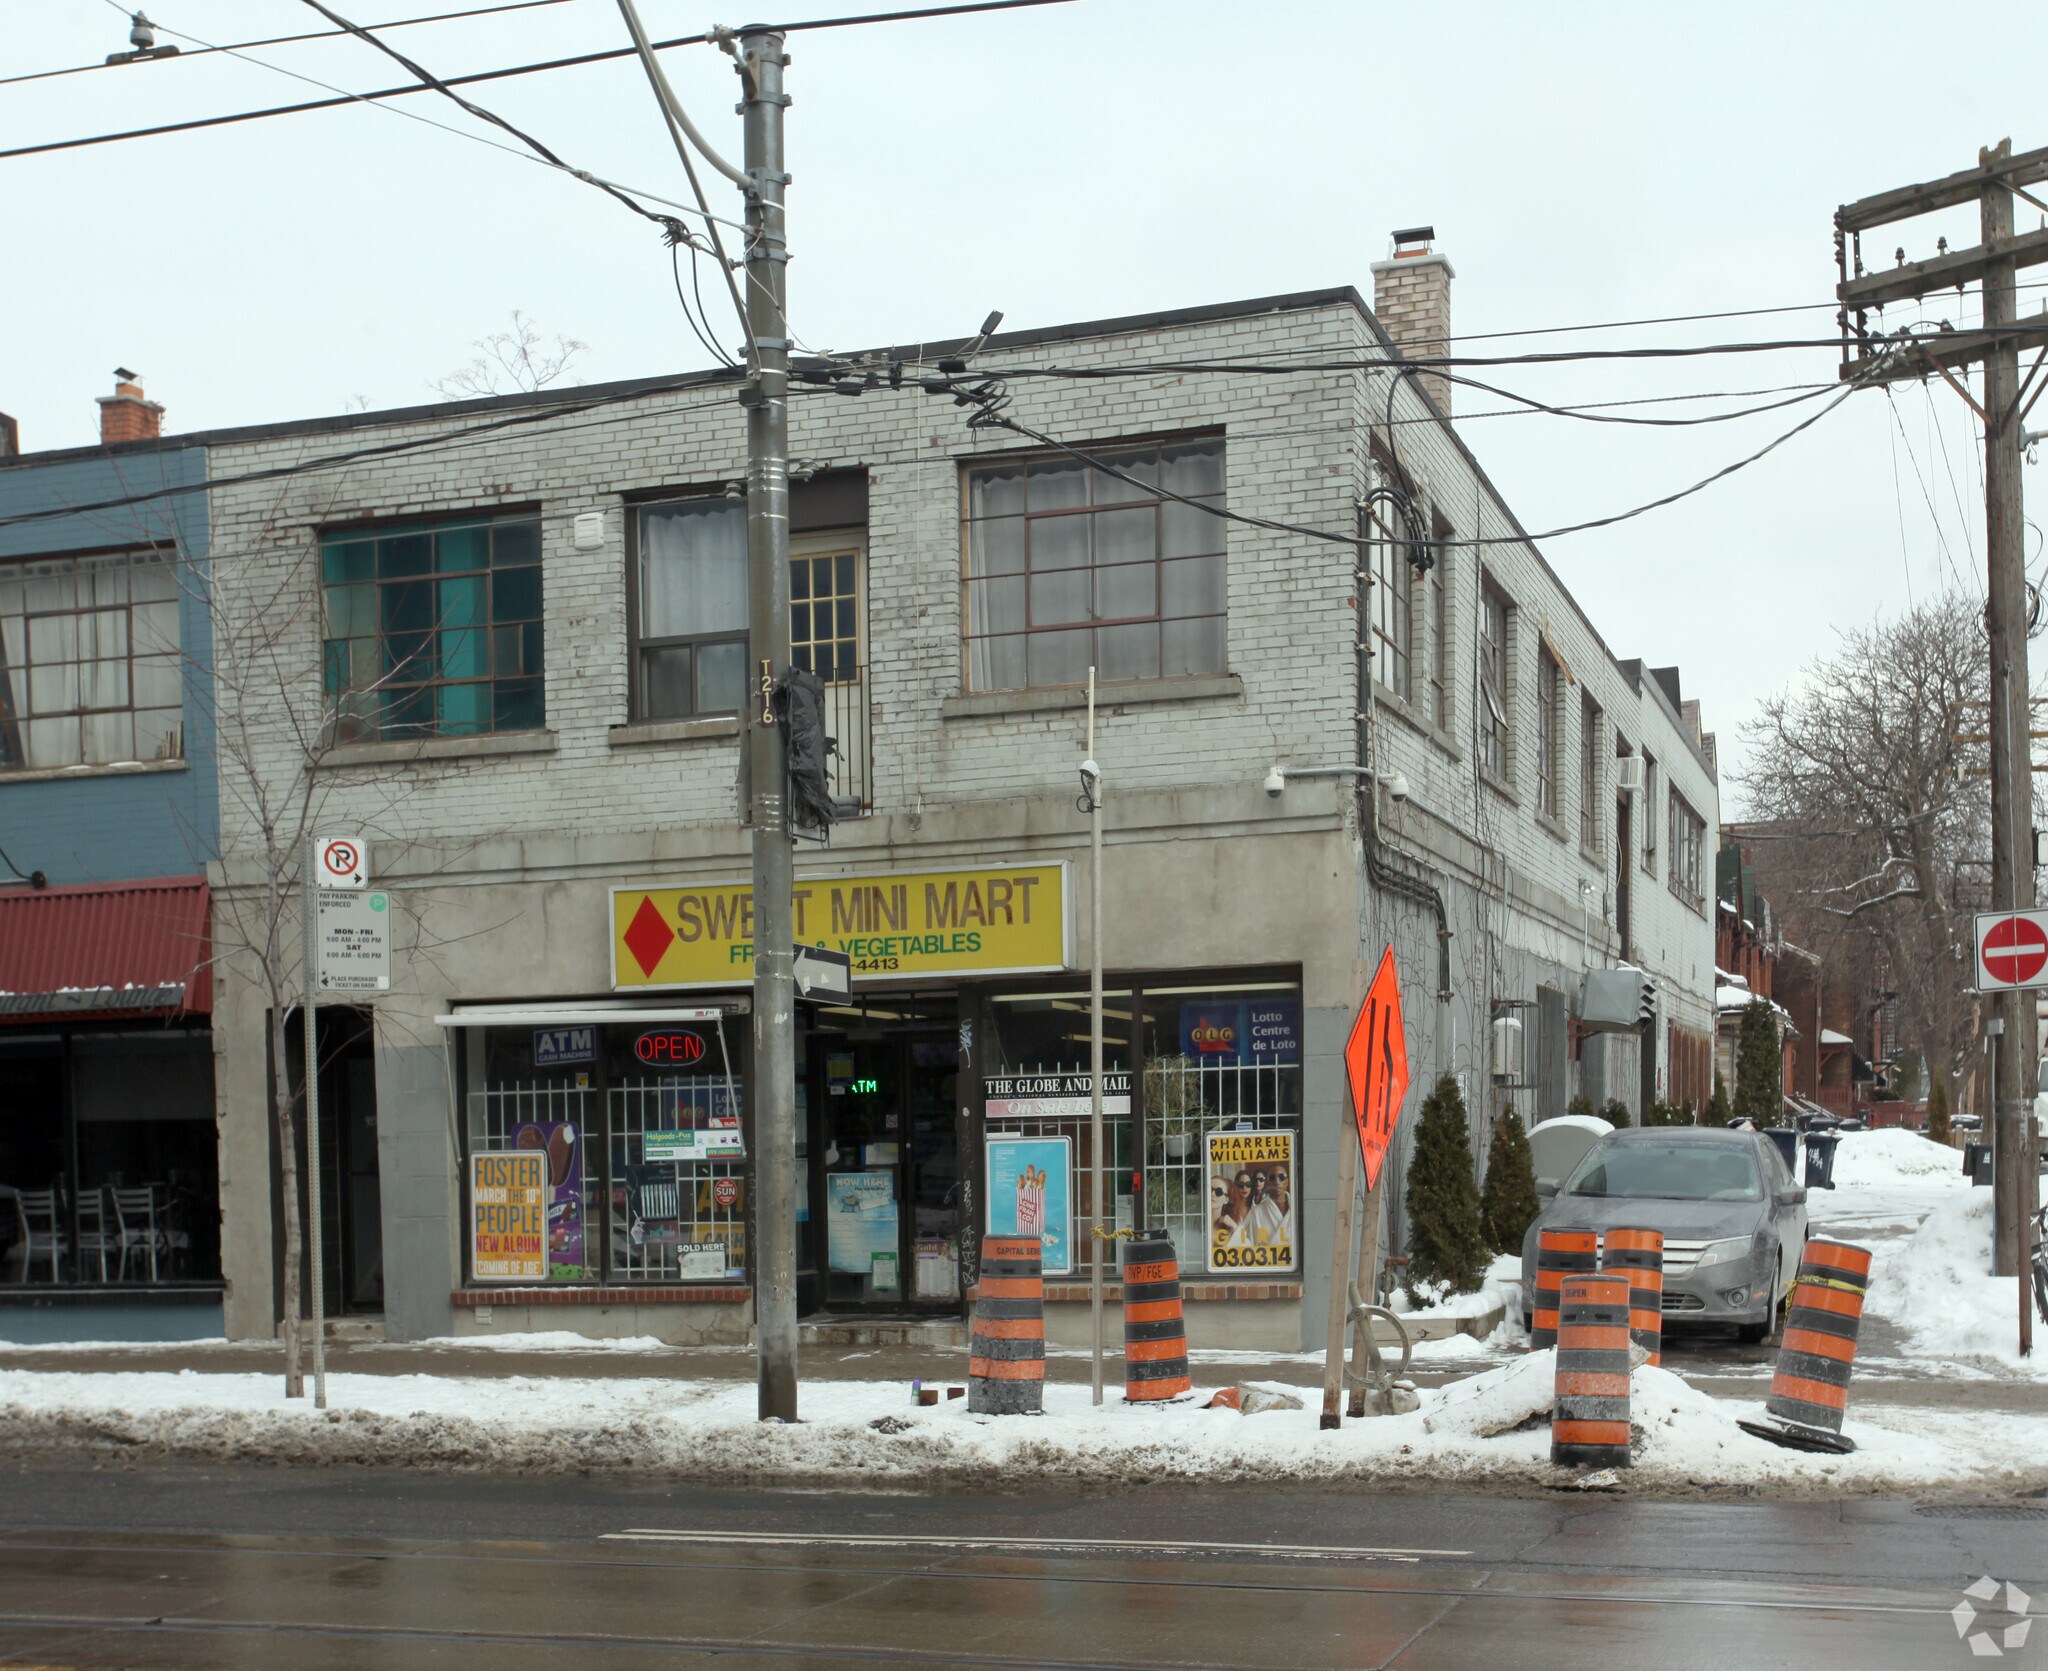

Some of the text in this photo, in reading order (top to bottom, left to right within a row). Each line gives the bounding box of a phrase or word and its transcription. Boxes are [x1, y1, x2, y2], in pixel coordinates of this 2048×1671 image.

[761, 659, 774, 723] T216
[331, 893, 359, 901] PARKING
[677, 889, 813, 943] SWET
[831, 884, 908, 935] MINI
[925, 876, 1039, 930] MART
[838, 931, 982, 958] VEGETABLES
[90, 986, 172, 1012] Lounge
[1252, 1012, 1283, 1023] Lotto
[1252, 1025, 1290, 1036] Centre
[538, 1029, 592, 1054] ATM
[638, 1036, 700, 1060] OPEN
[1252, 1039, 1296, 1050] de Loto
[538, 1051, 592, 1062] CASH MACHINE
[985, 1080, 1012, 1094] THE
[1016, 1079, 1060, 1093] GLOBE
[1064, 1077, 1092, 1092] AND
[1007, 1101, 1032, 1115] On
[1035, 1099, 1068, 1114] Sale
[1210, 1136, 1289, 1150] PHARRELL
[1210, 1148, 1290, 1162] WILLIAMS
[475, 1158, 540, 1187] FOSTER
[475, 1188, 506, 1203] MARCH
[508, 1188, 524, 1203] THE
[716, 1187, 736, 1196] SUN
[476, 1205, 540, 1234] PEOPLE
[1215, 1226, 1290, 1245] GIRL
[476, 1235, 541, 1253] NEW ALBUM
[678, 1243, 725, 1253] SOLD HERE
[996, 1246, 1025, 1255] CAPITAL
[1213, 1246, 1292, 1268] 03.03.14
[511, 1260, 521, 1274] OF
